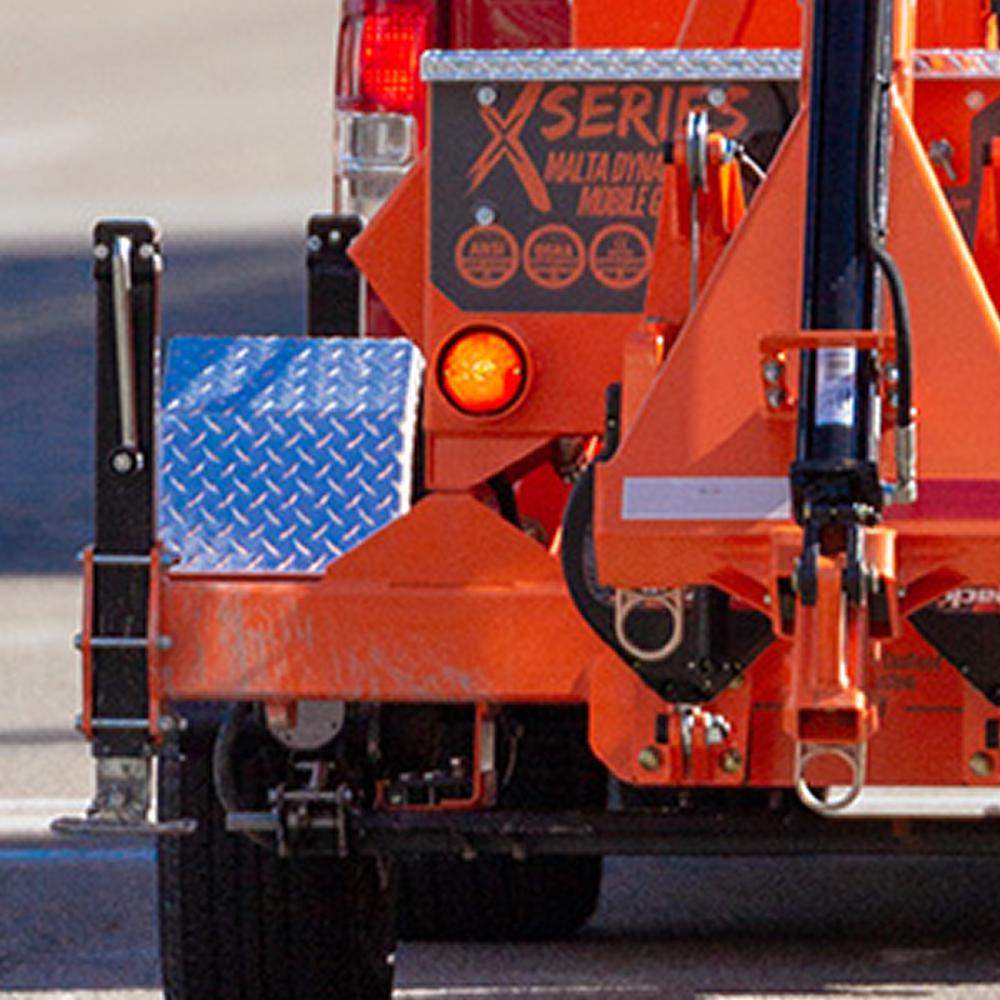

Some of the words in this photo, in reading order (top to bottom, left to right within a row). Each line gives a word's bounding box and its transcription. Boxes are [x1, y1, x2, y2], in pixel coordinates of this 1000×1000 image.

[465, 81, 551, 213] X
[540, 84, 749, 148] SERIES
[544, 150, 609, 184] MALTA
[575, 185, 646, 217] MOBILE
